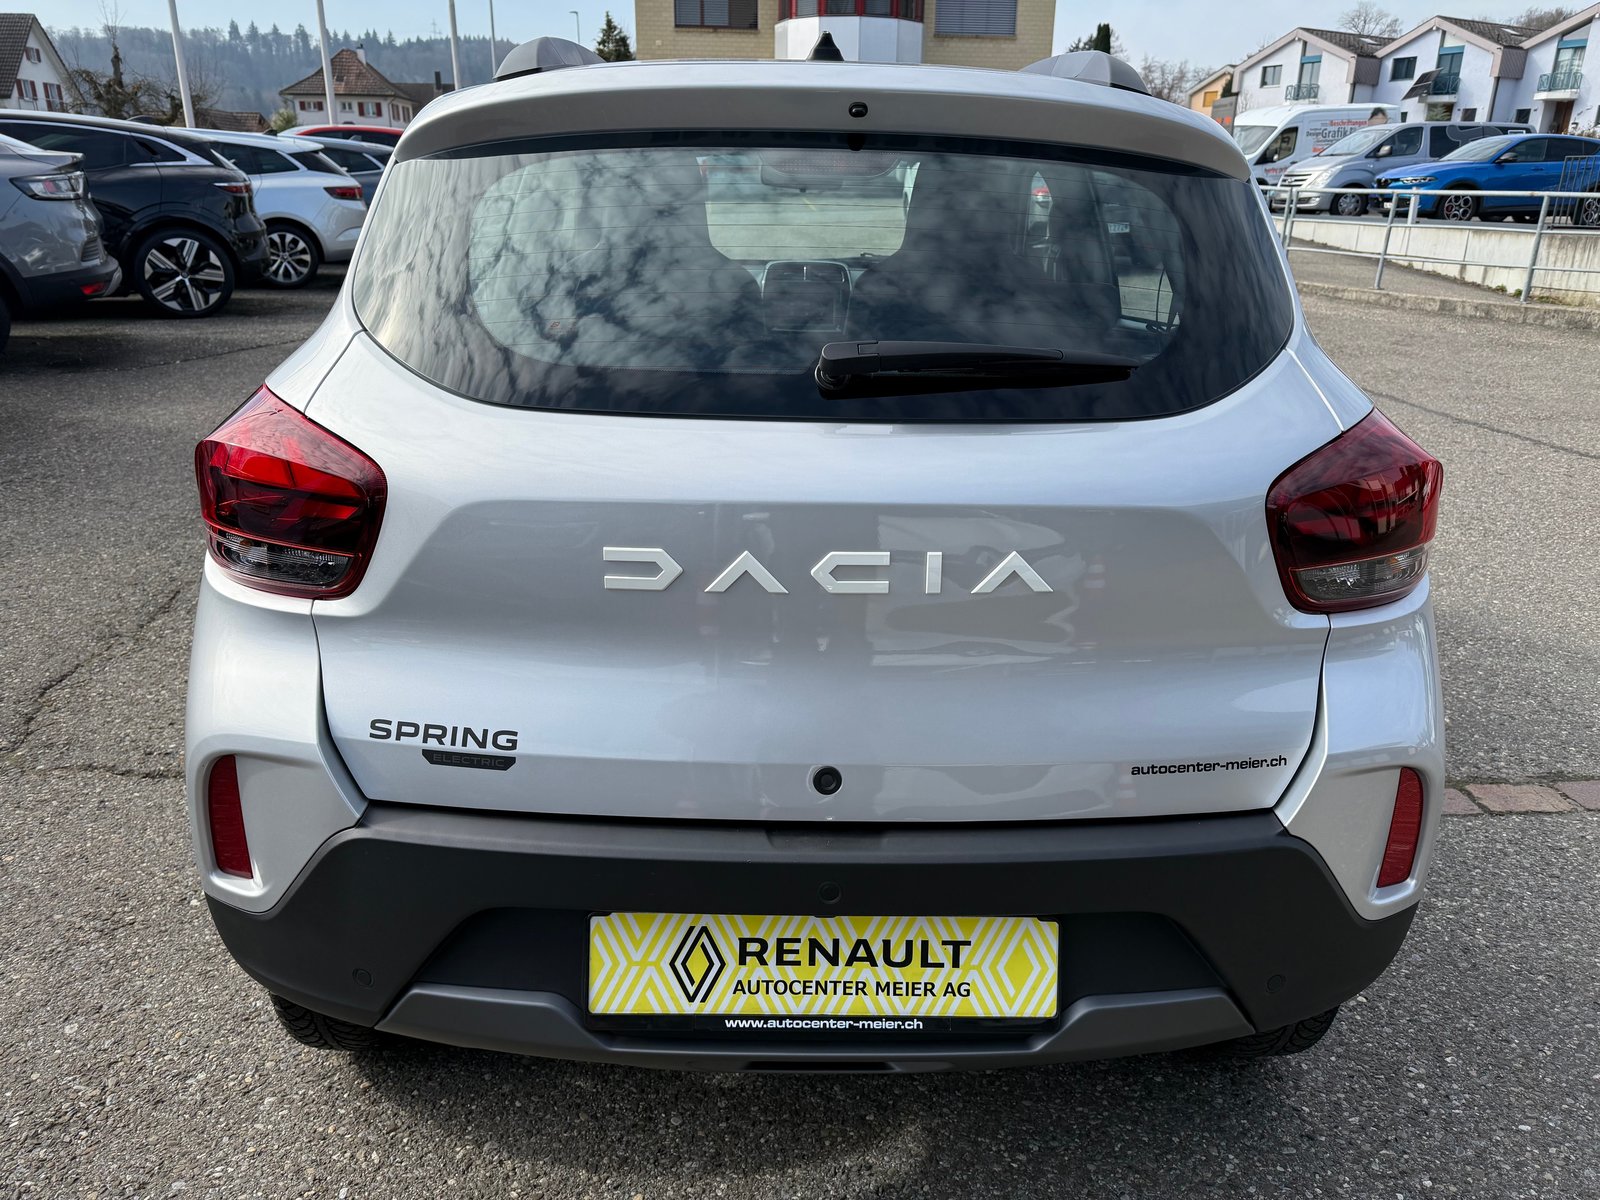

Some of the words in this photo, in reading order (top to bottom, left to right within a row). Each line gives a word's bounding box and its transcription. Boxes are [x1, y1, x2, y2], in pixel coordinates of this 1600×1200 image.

[1321, 127, 1348, 139] Grafik
[603, 546, 1053, 594] DACIA
[369, 718, 519, 751] SPRING
[433, 753, 506, 767] ELECTRIC
[1131, 755, 1287, 776] autocenter-meier.ch
[737, 937, 972, 969] RENAULT
[732, 979, 868, 997] AUTOCENTER
[875, 980, 936, 997] MEIER
[942, 981, 971, 998] AG
[724, 1016, 924, 1031] www.autocenter-meier.ch
